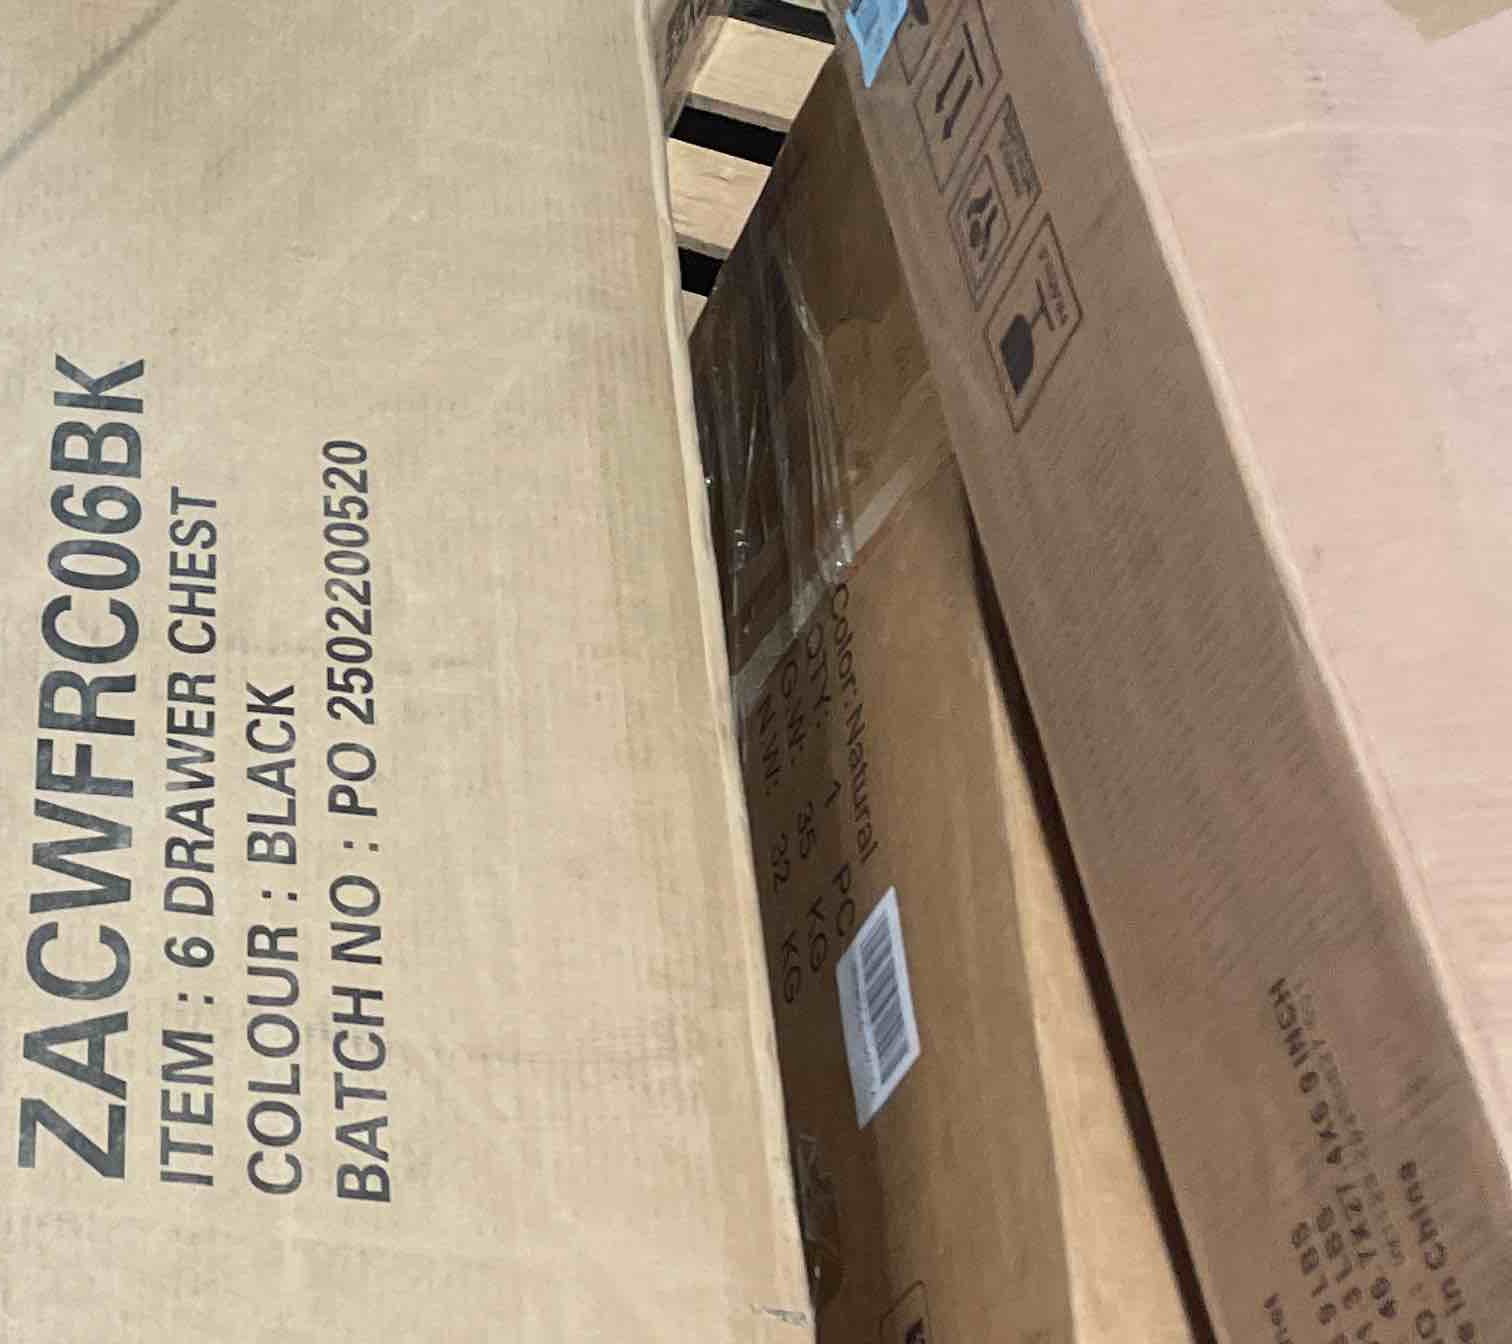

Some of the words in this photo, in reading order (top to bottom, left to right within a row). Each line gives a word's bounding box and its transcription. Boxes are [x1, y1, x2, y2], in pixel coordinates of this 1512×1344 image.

[169, 485, 219, 655] CHEST
[322, 439, 376, 727] 2502200520
[17, 352, 147, 1181] ZACWFRC06BK
[163, 669, 217, 917] DRAWER
[246, 681, 298, 865] BLACK
[327, 740, 379, 819] PO
[163, 936, 215, 969] 6
[328, 874, 384, 965] NO
[771, 832, 790, 894] 32
[781, 927, 801, 1004] KG
[797, 801, 816, 859] 35
[807, 895, 828, 974] KG
[160, 1030, 216, 1188] ITEM
[246, 923, 304, 1197] COLOUR
[336, 984, 392, 1205] BATCH
[1398, 1160, 1448, 1271] China
[1442, 1275, 1467, 1318] in
